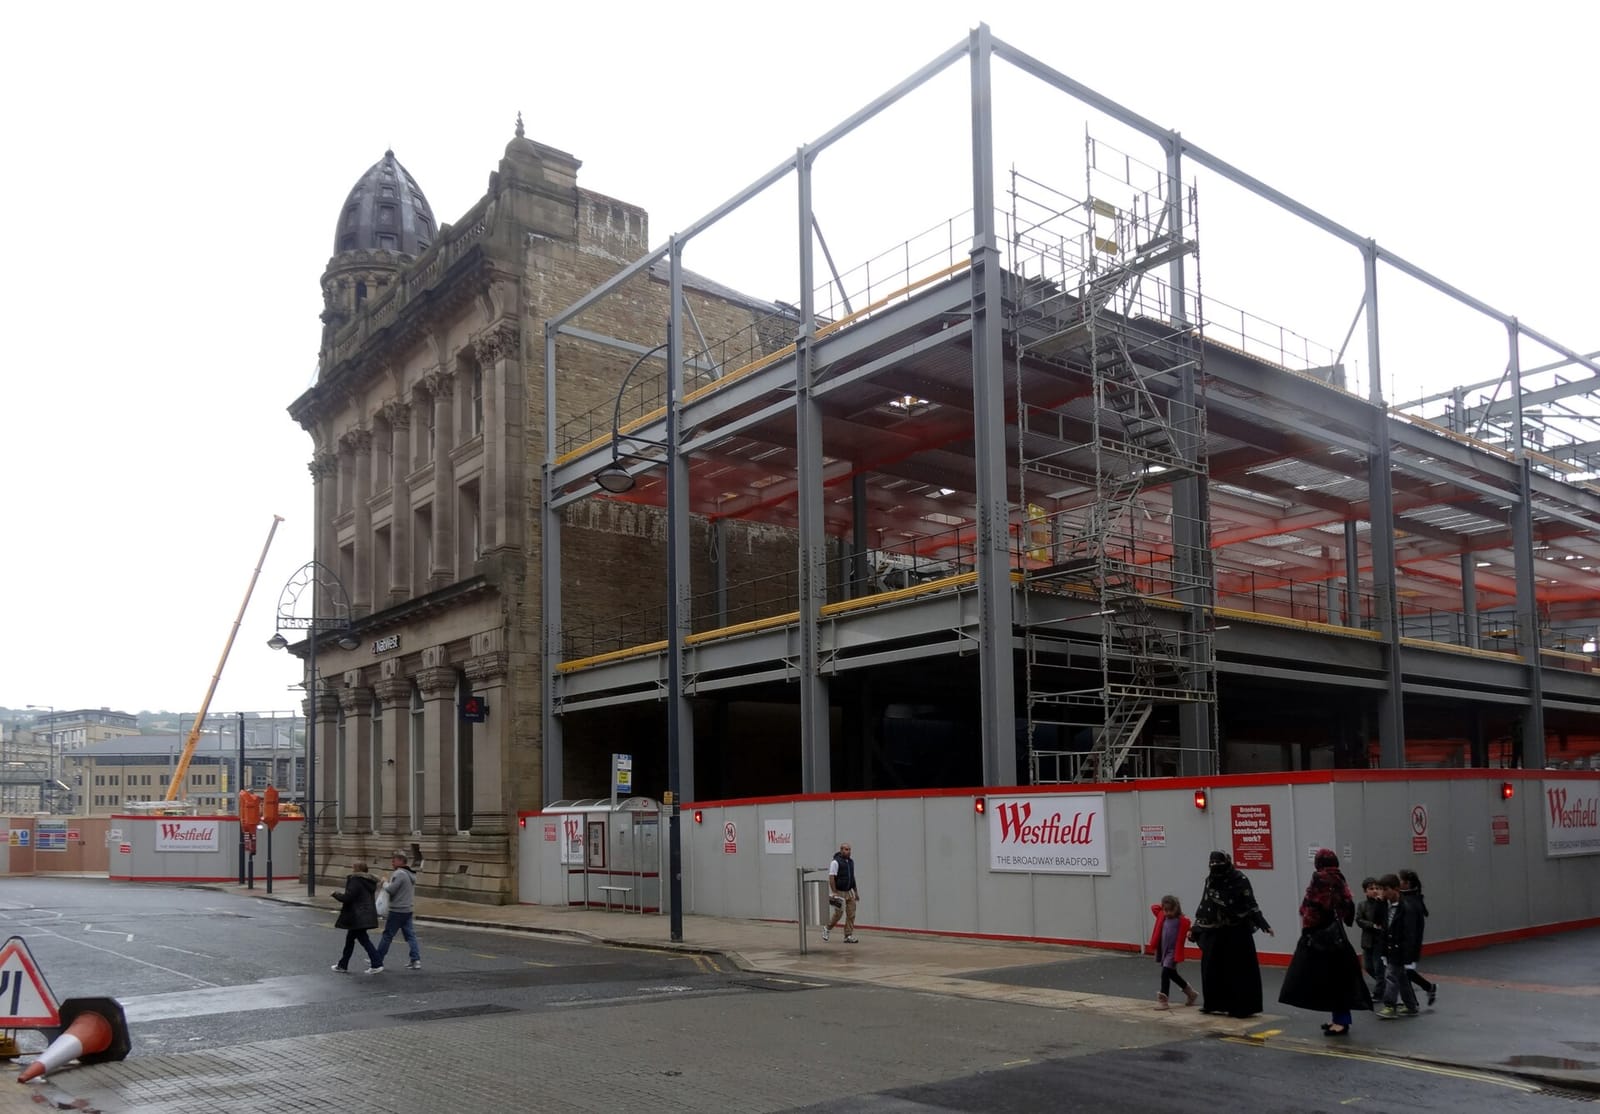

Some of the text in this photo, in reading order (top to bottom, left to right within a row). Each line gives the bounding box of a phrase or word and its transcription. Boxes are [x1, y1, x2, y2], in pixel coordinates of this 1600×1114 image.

[1547, 787, 1598, 828] Westfield
[995, 801, 1096, 844] Westfield
[1235, 820, 1258, 828] Looking
[161, 823, 214, 841] Westfield
[997, 855, 1099, 867] THE BROADWAY BRADFORD
